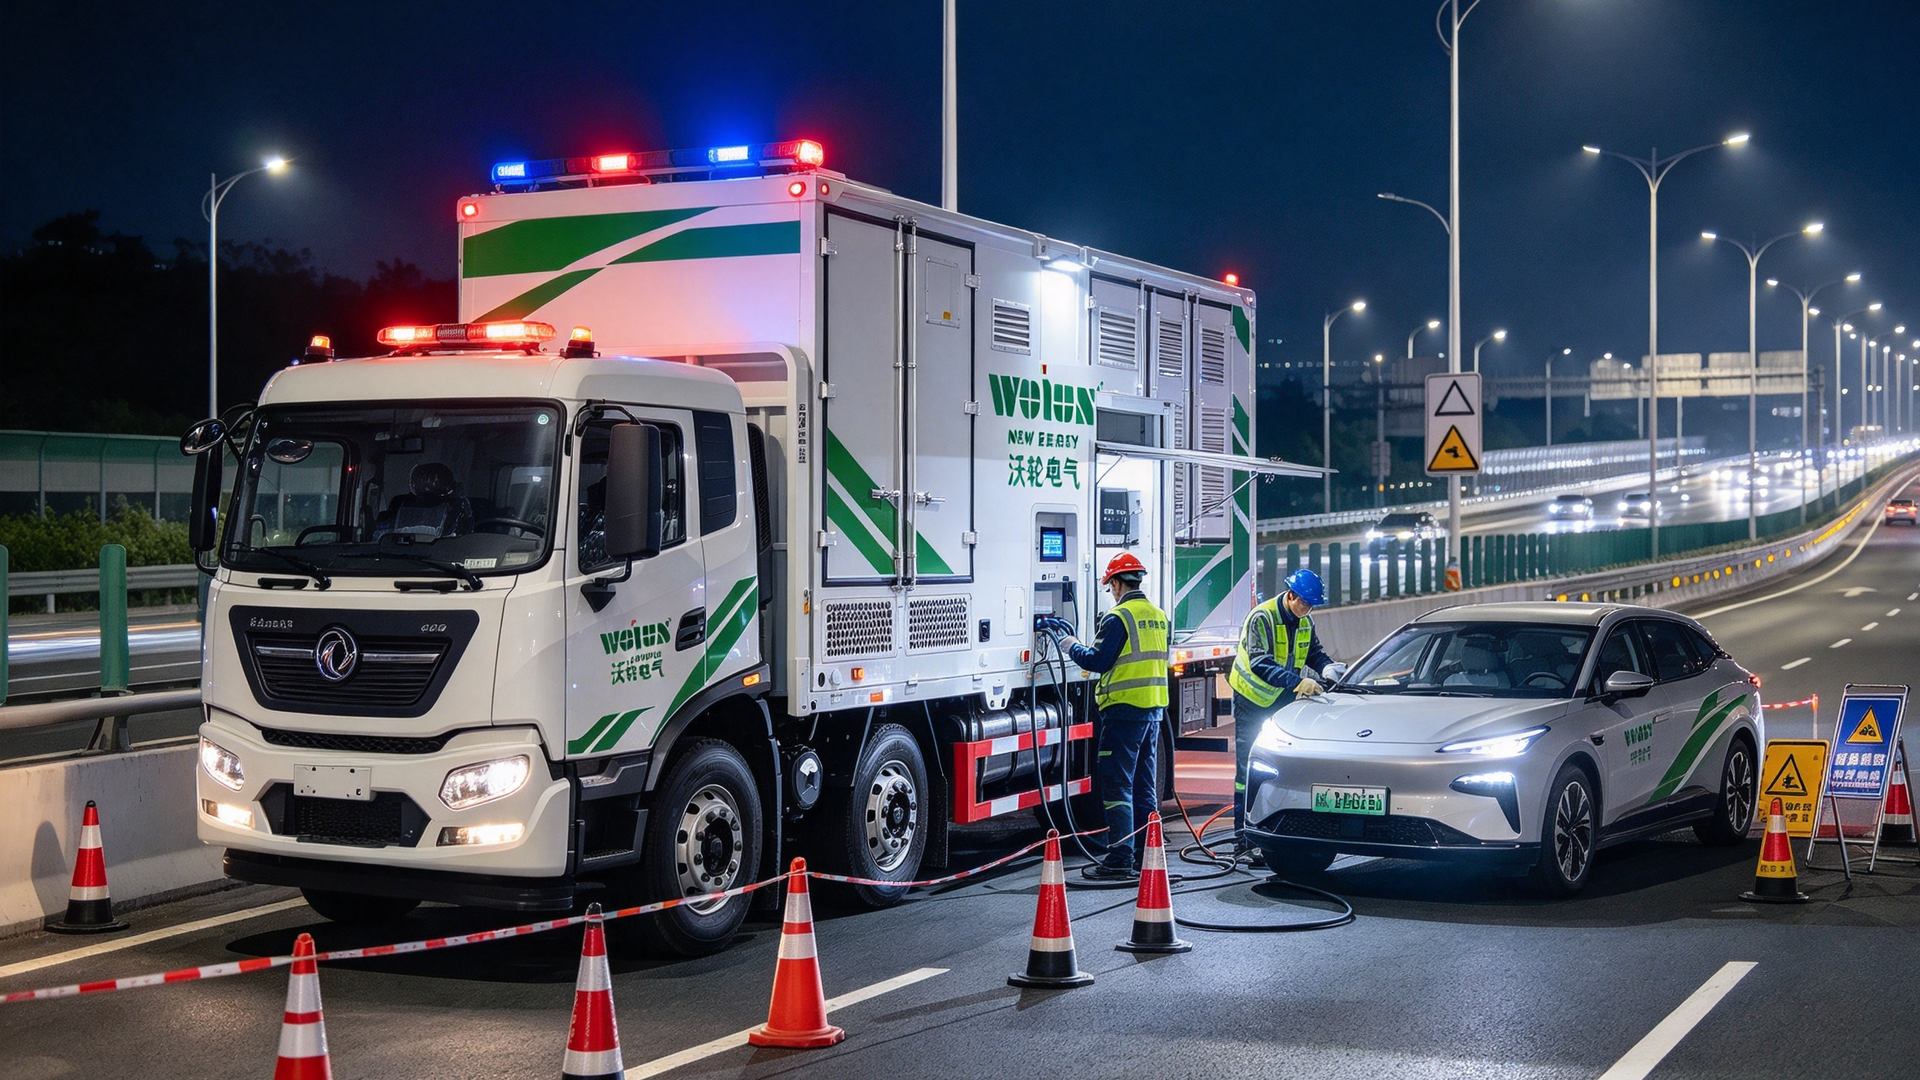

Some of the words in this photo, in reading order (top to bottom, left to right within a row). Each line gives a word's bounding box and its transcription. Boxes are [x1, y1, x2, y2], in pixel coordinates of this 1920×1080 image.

[1008, 429, 1035, 447] NEW
[1008, 453, 1081, 490] 沃轮电气
